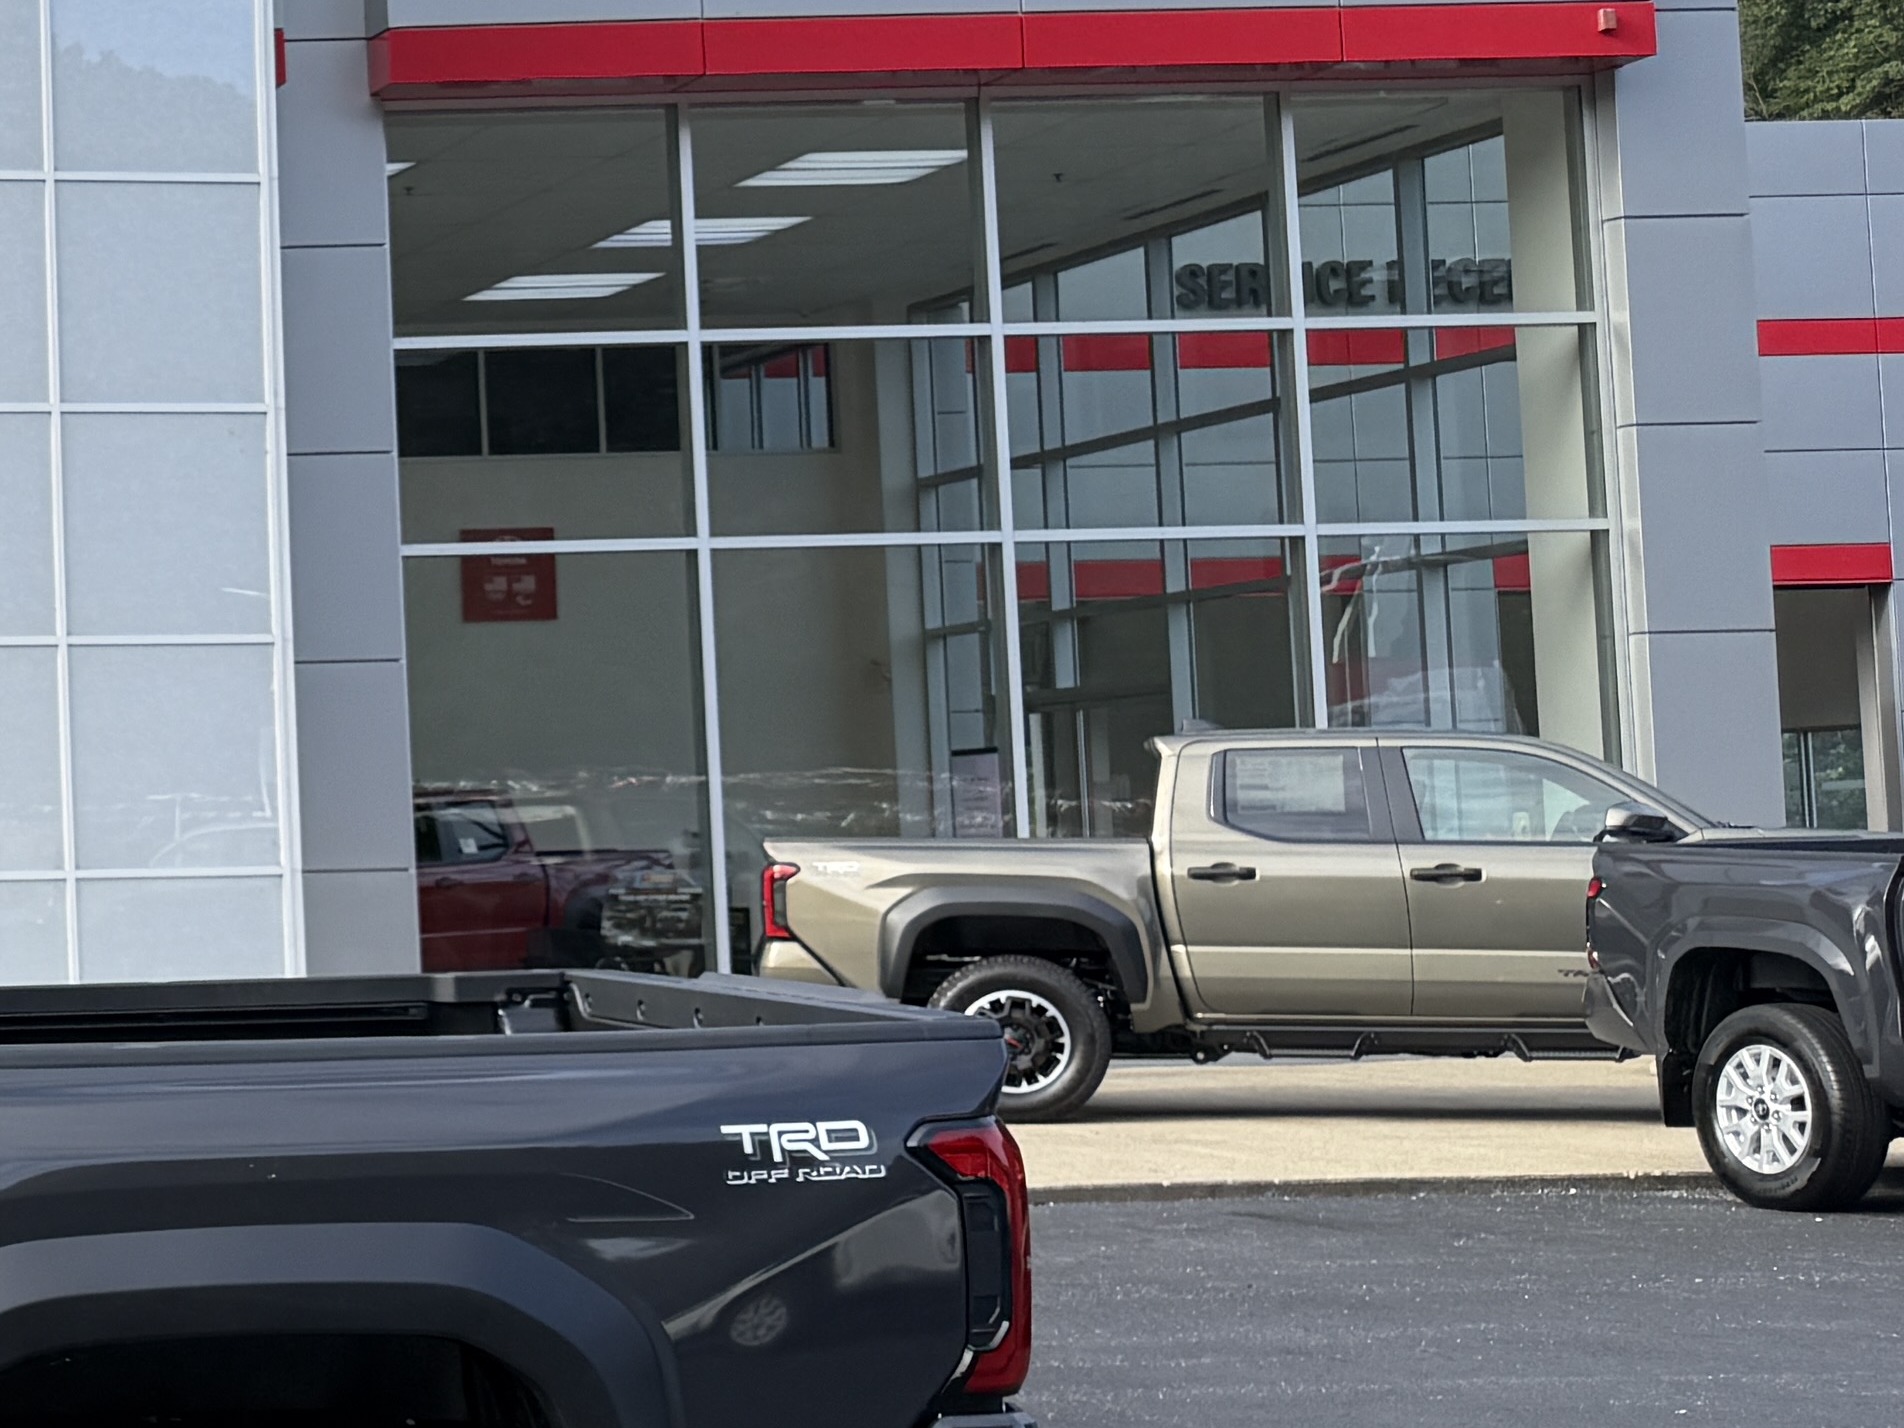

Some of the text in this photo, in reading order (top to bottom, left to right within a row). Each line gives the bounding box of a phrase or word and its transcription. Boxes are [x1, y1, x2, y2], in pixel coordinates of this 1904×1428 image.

[1175, 260, 1376, 310] SERICE
[720, 1120, 870, 1163] TRD
[725, 1164, 887, 1185] OFF ROAD
